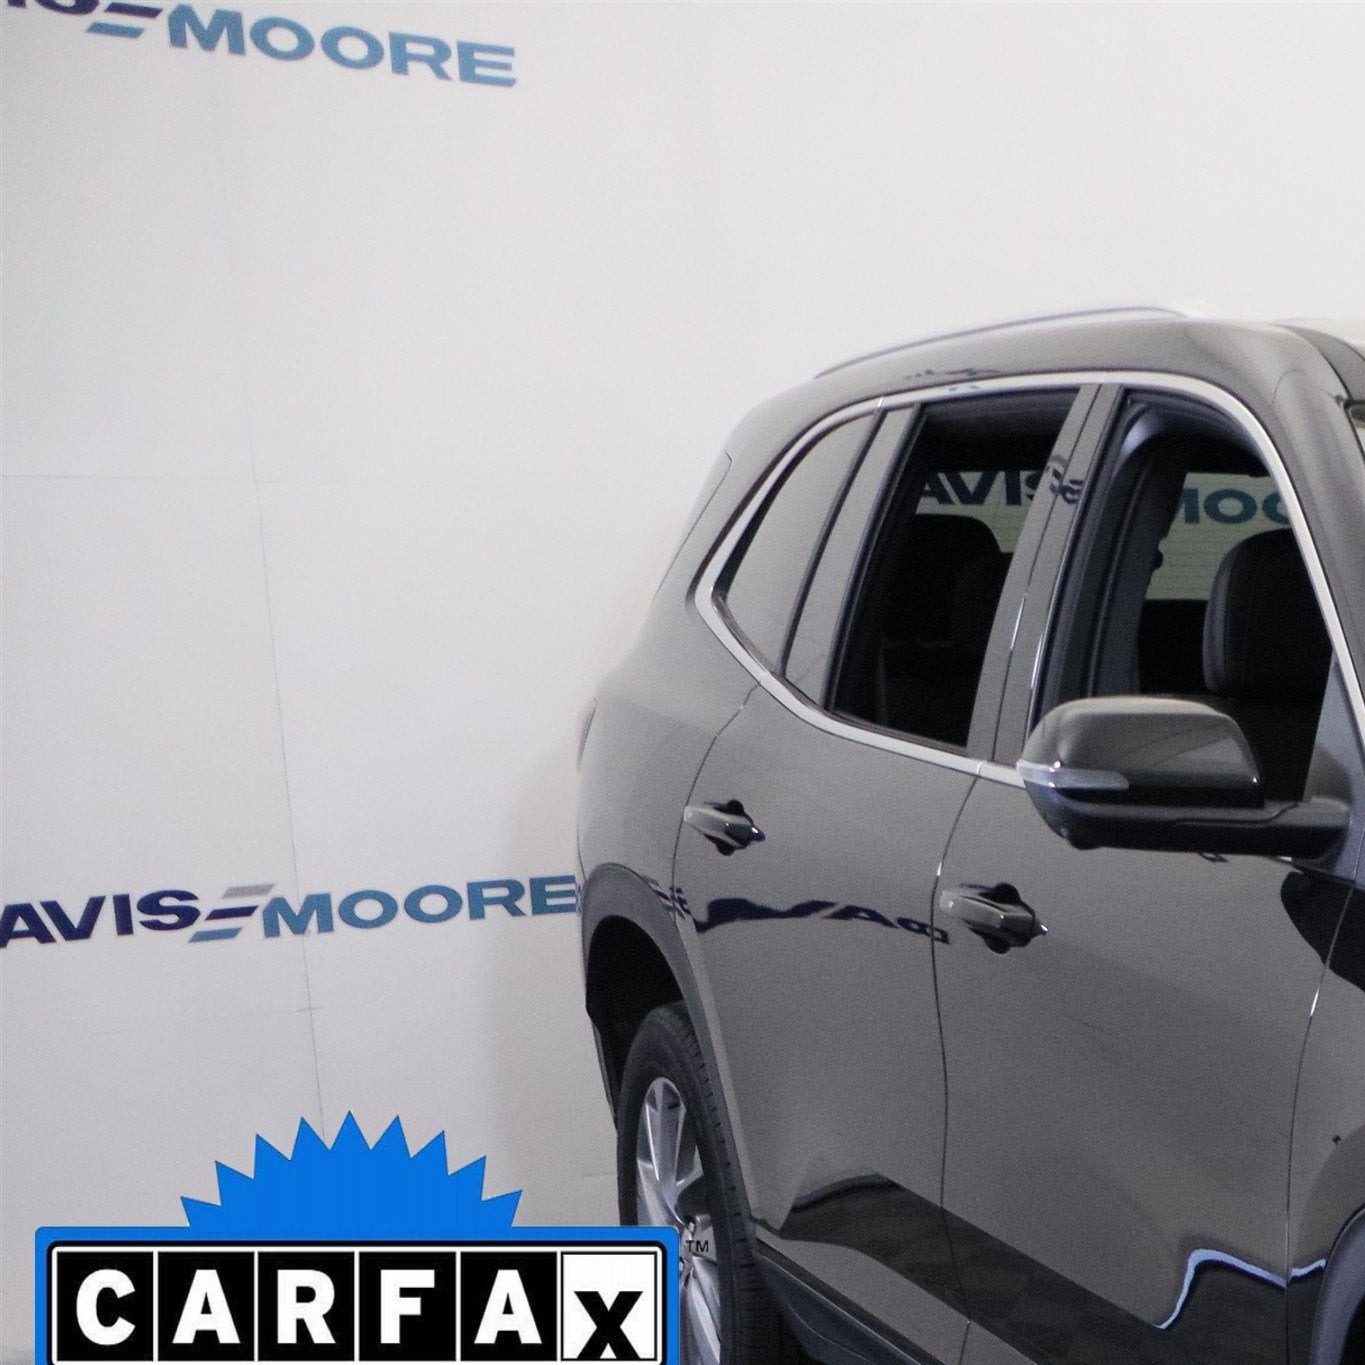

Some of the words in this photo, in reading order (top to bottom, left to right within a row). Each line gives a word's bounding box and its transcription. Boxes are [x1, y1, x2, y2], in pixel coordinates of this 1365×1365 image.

[168, 3, 515, 87] MOORE
[918, 470, 1041, 506] AVI
[0, 889, 201, 949] AVIS
[262, 874, 577, 938] MOORE
